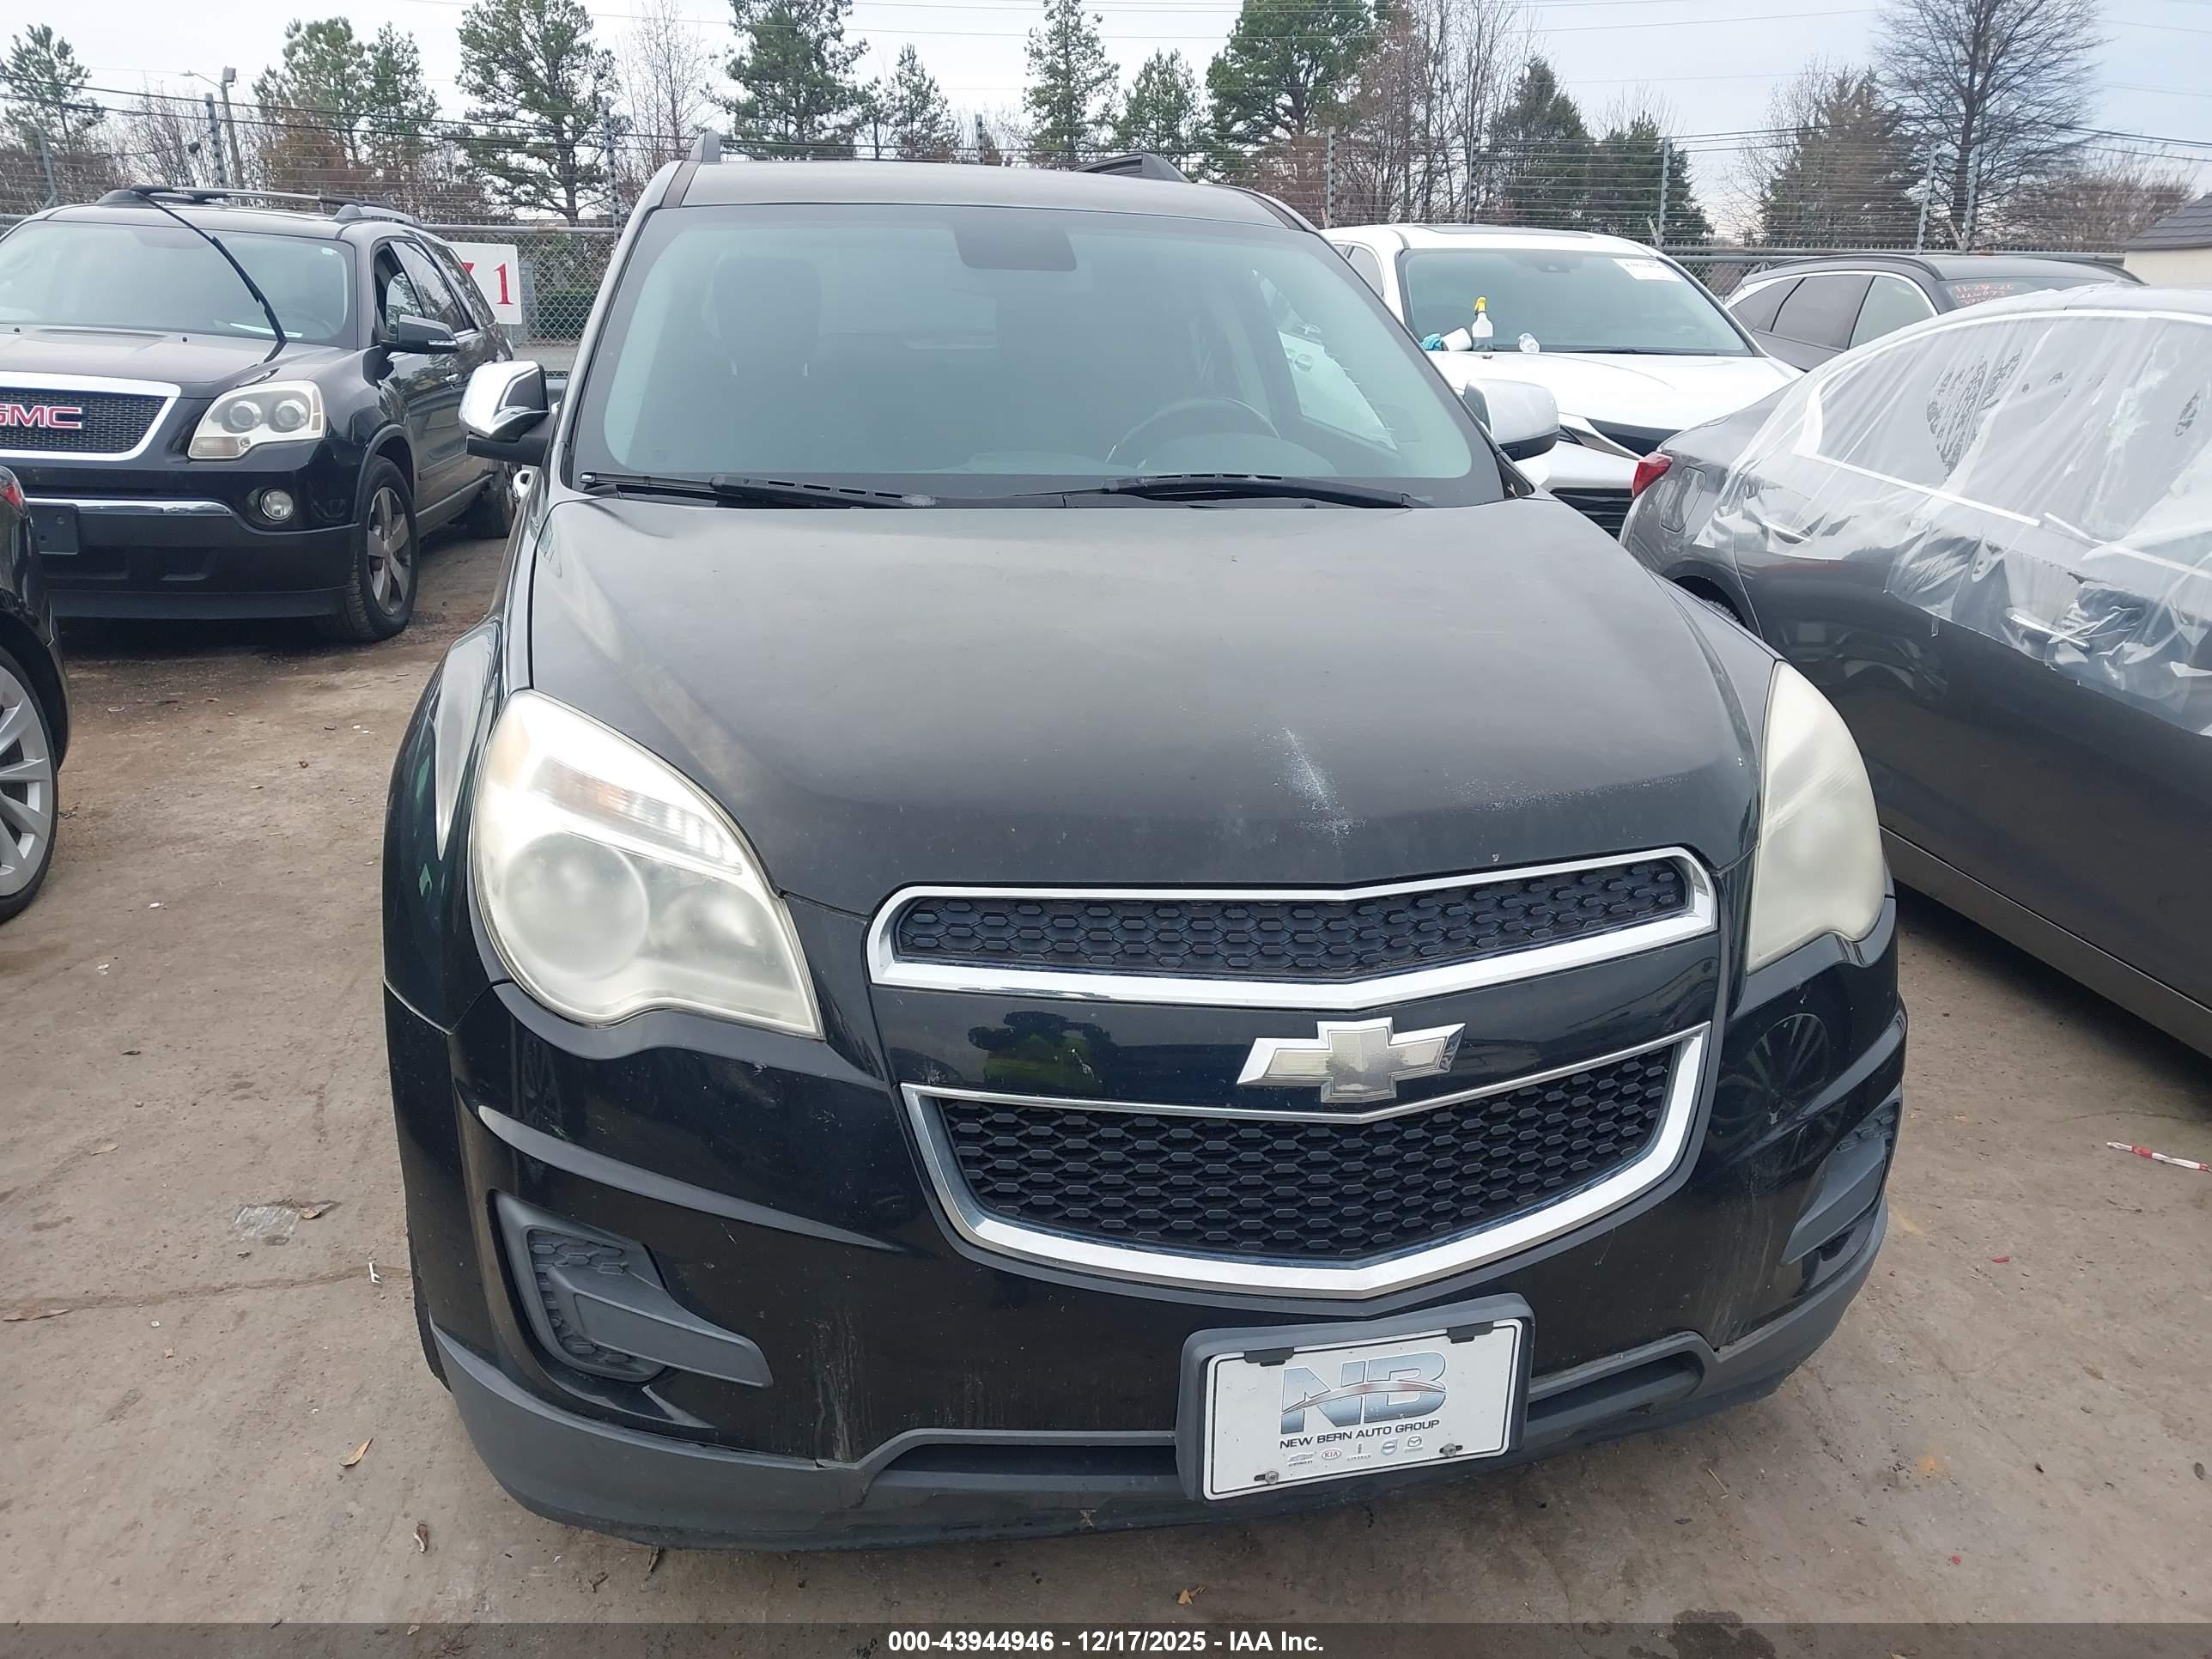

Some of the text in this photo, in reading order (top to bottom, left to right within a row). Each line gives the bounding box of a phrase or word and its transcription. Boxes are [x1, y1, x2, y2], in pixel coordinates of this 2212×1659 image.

[0, 403, 82, 429] MC
[1280, 1352, 1447, 1434] NB
[1279, 1419, 1440, 1449] NEW BERN AUTO GROUP
[1323, 1450, 1340, 1459] KIA
